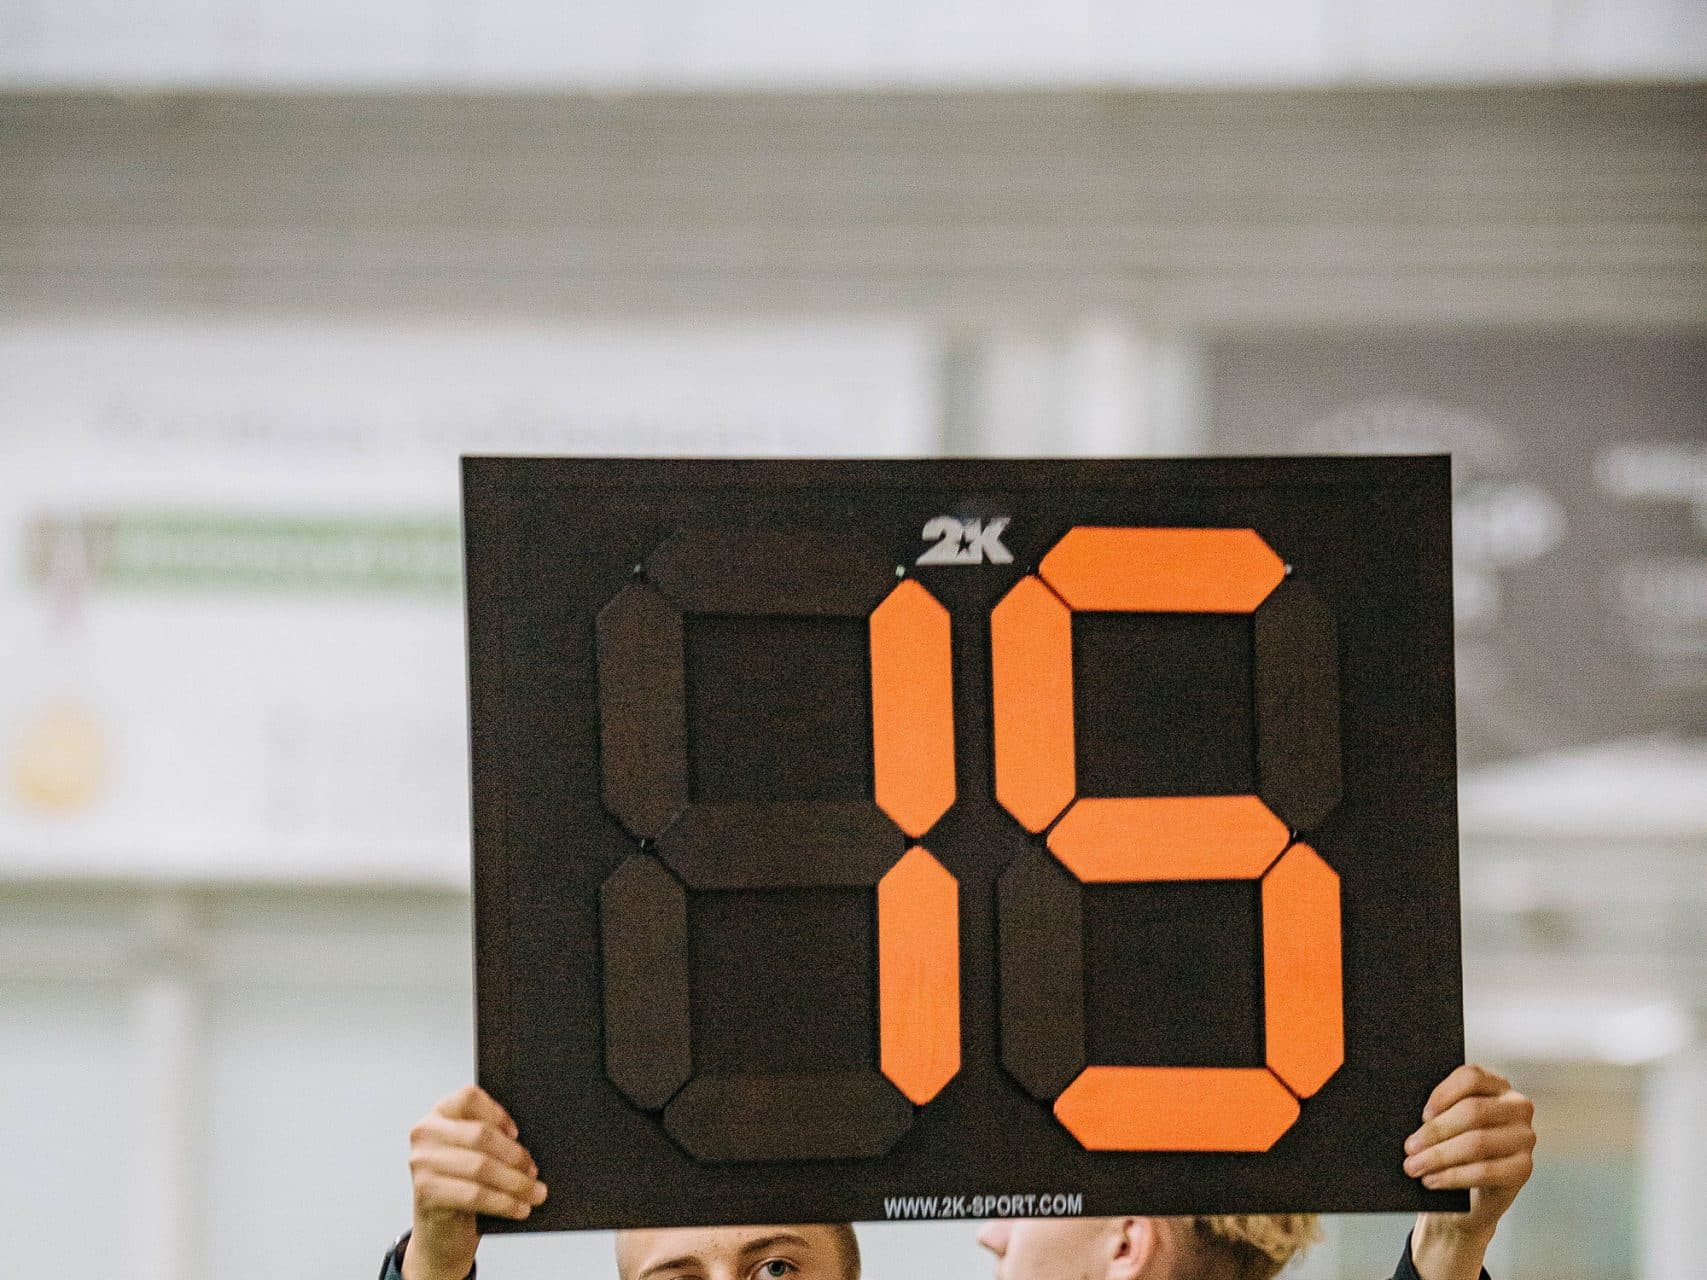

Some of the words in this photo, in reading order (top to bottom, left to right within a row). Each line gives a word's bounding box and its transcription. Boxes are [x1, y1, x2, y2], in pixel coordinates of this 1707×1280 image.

[916, 516, 1014, 566] 2K
[869, 526, 1344, 1152] 15
[883, 1193, 1083, 1220] WWW.2K-SPORT.COM
